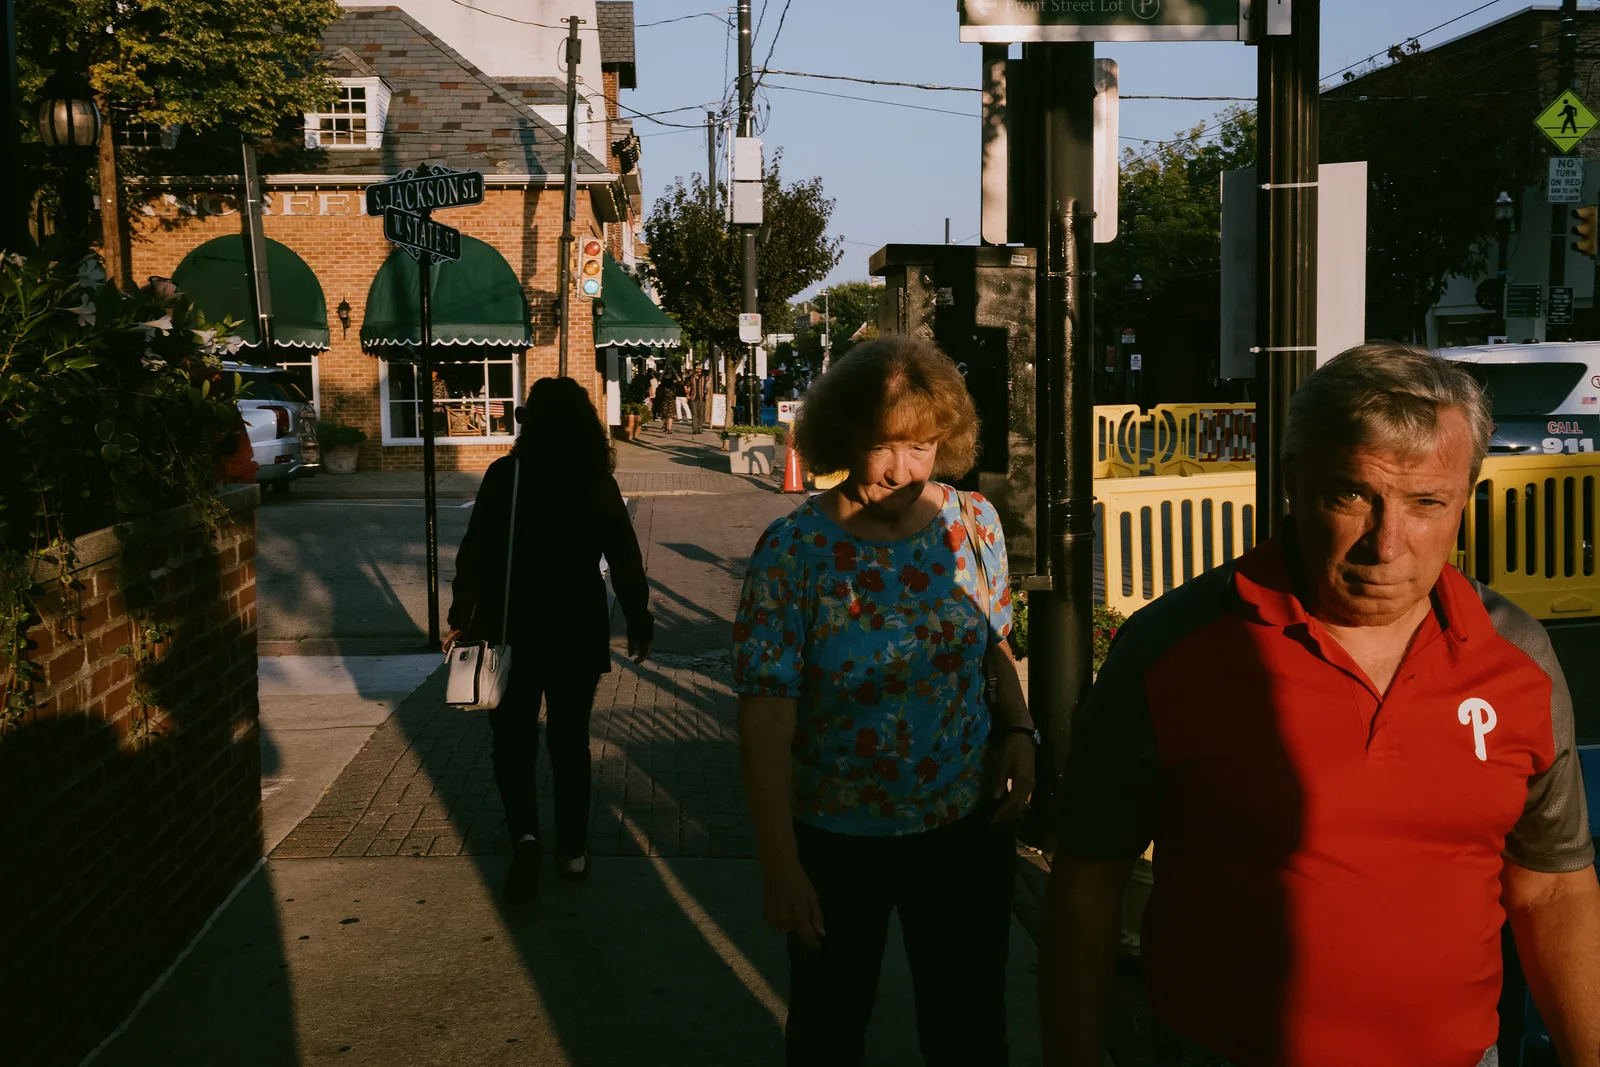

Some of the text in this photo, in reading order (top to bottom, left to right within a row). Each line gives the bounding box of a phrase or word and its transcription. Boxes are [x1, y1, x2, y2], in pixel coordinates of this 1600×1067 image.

[1051, 0, 1094, 12] Street
[1099, 0, 1123, 12] Lot
[1557, 159, 1574, 168] NO
[1555, 169, 1576, 177] TURN
[1551, 178, 1581, 186] ON RED
[375, 177, 478, 210] S. JACKSON ST.
[393, 214, 456, 253] W. STATE ST.
[1547, 421, 1583, 434] CALL
[1541, 437, 1594, 454] 911
[1457, 697, 1497, 761] P
